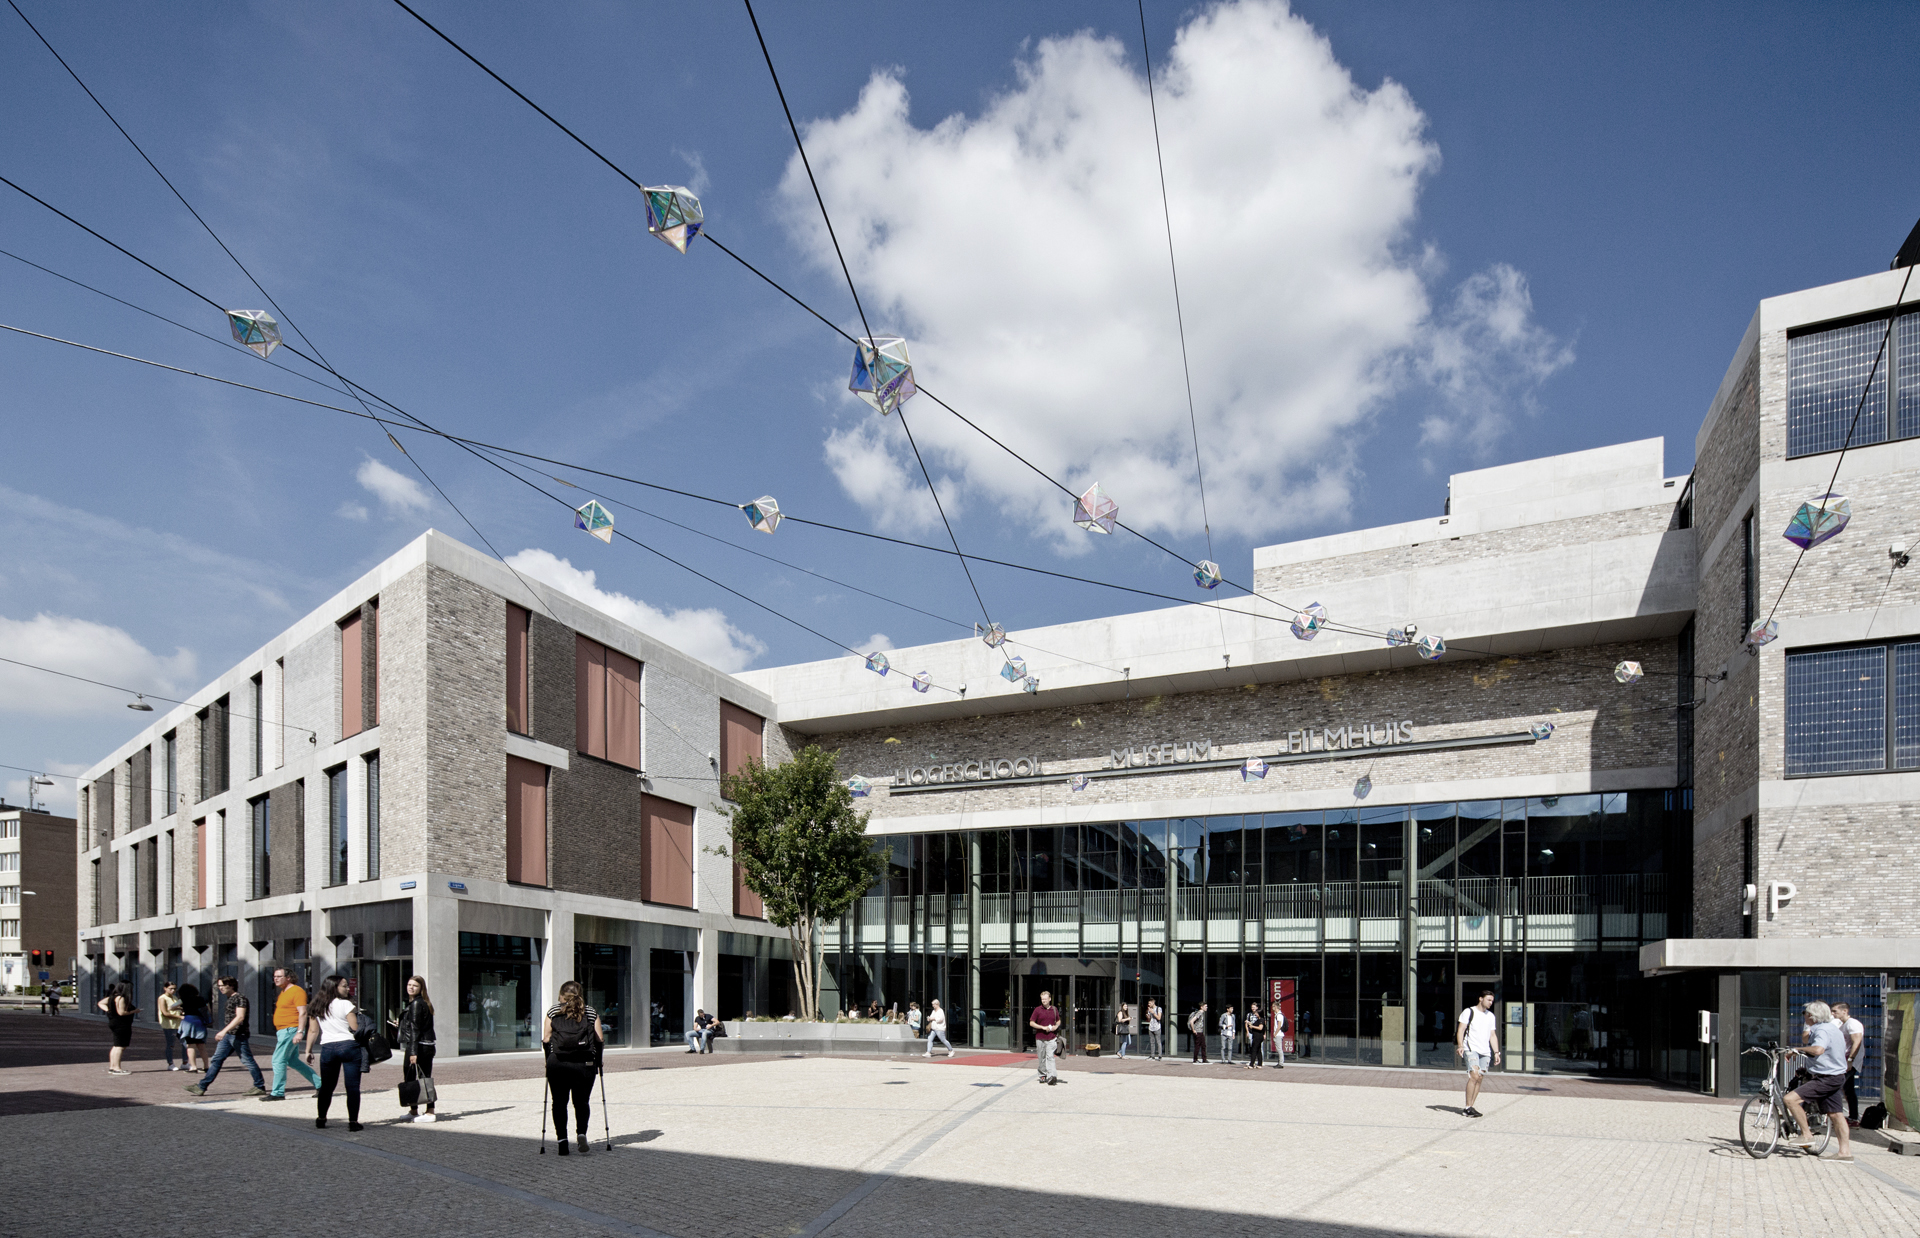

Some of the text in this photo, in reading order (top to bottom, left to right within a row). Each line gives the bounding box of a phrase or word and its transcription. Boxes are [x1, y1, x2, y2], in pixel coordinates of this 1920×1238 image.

[894, 720, 1413, 786] HOGESCHOOL MUSEUM FILMHUIS
[1771, 880, 1797, 913] P
